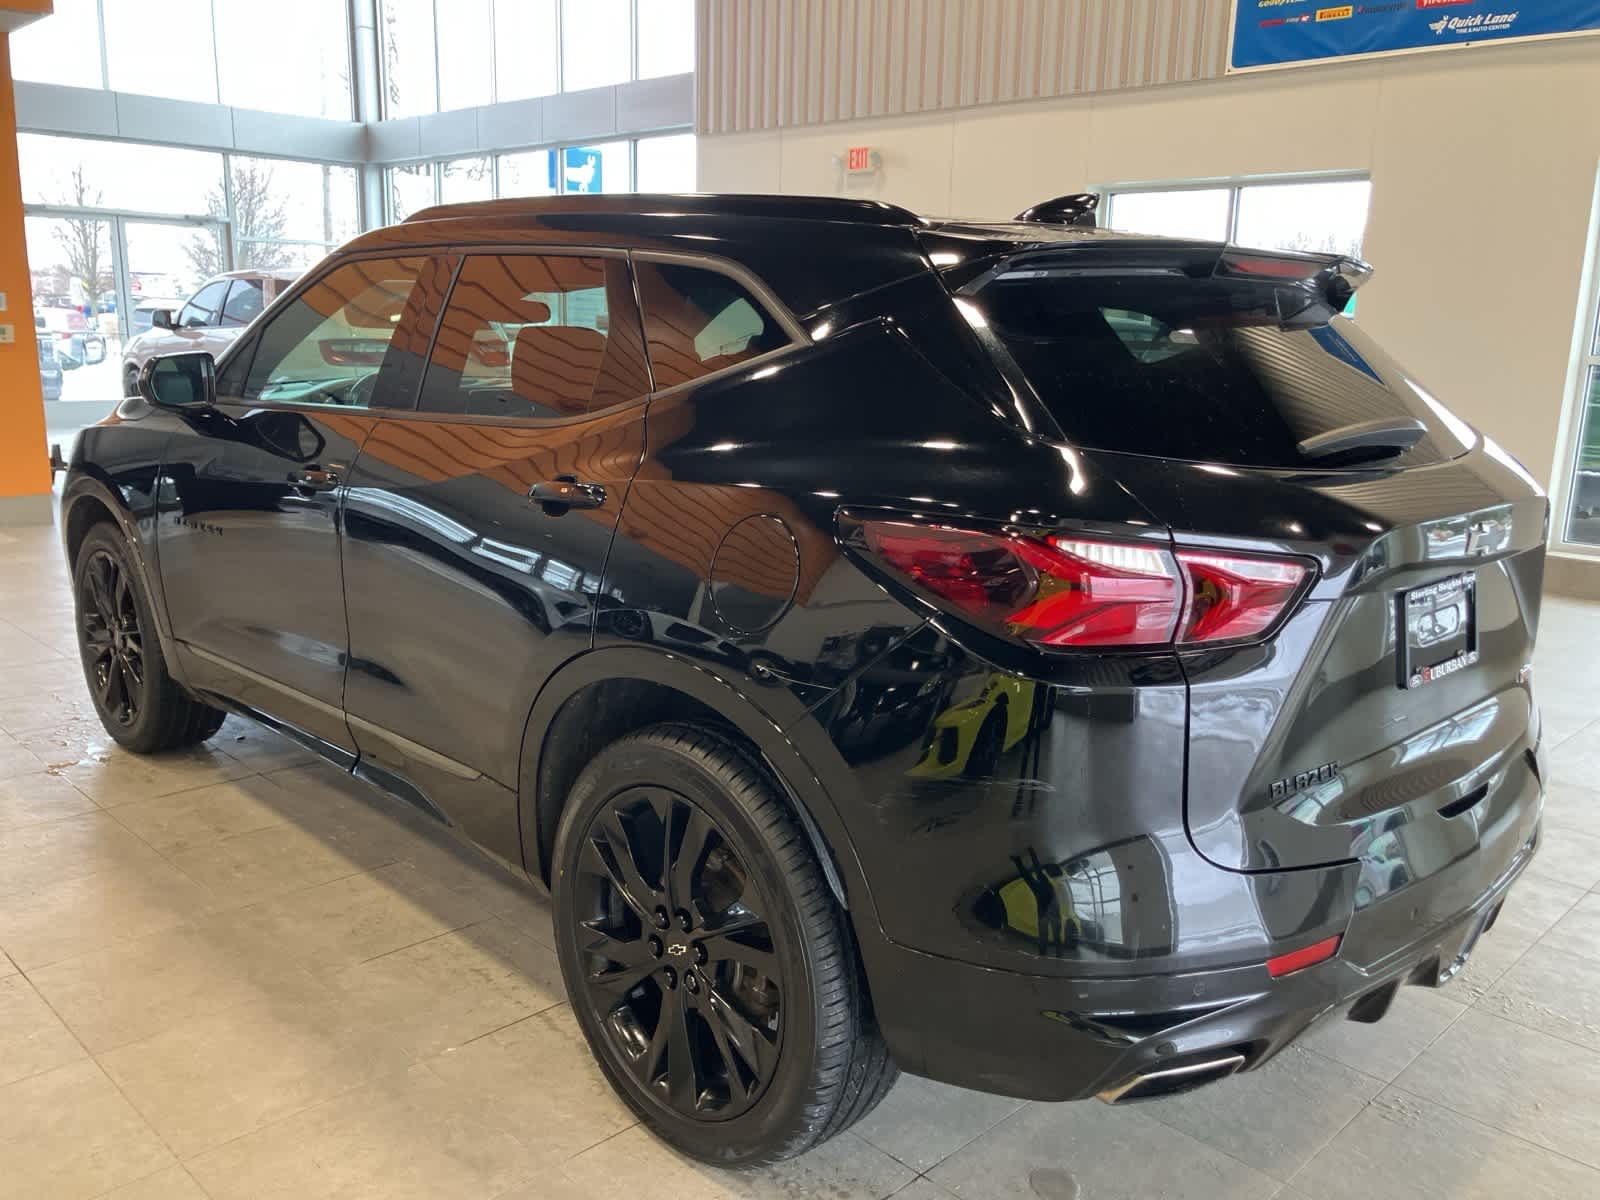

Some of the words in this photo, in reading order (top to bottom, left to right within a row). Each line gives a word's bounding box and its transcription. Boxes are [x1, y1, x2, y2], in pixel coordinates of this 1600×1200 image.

[1448, 14, 1484, 29] Quick
[1484, 13, 1517, 25] Lane
[1488, 23, 1511, 31] CENTER
[849, 147, 868, 170] EXIT
[1423, 655, 1467, 684] SUBURBAN
[1268, 763, 1338, 799] BLAZER
